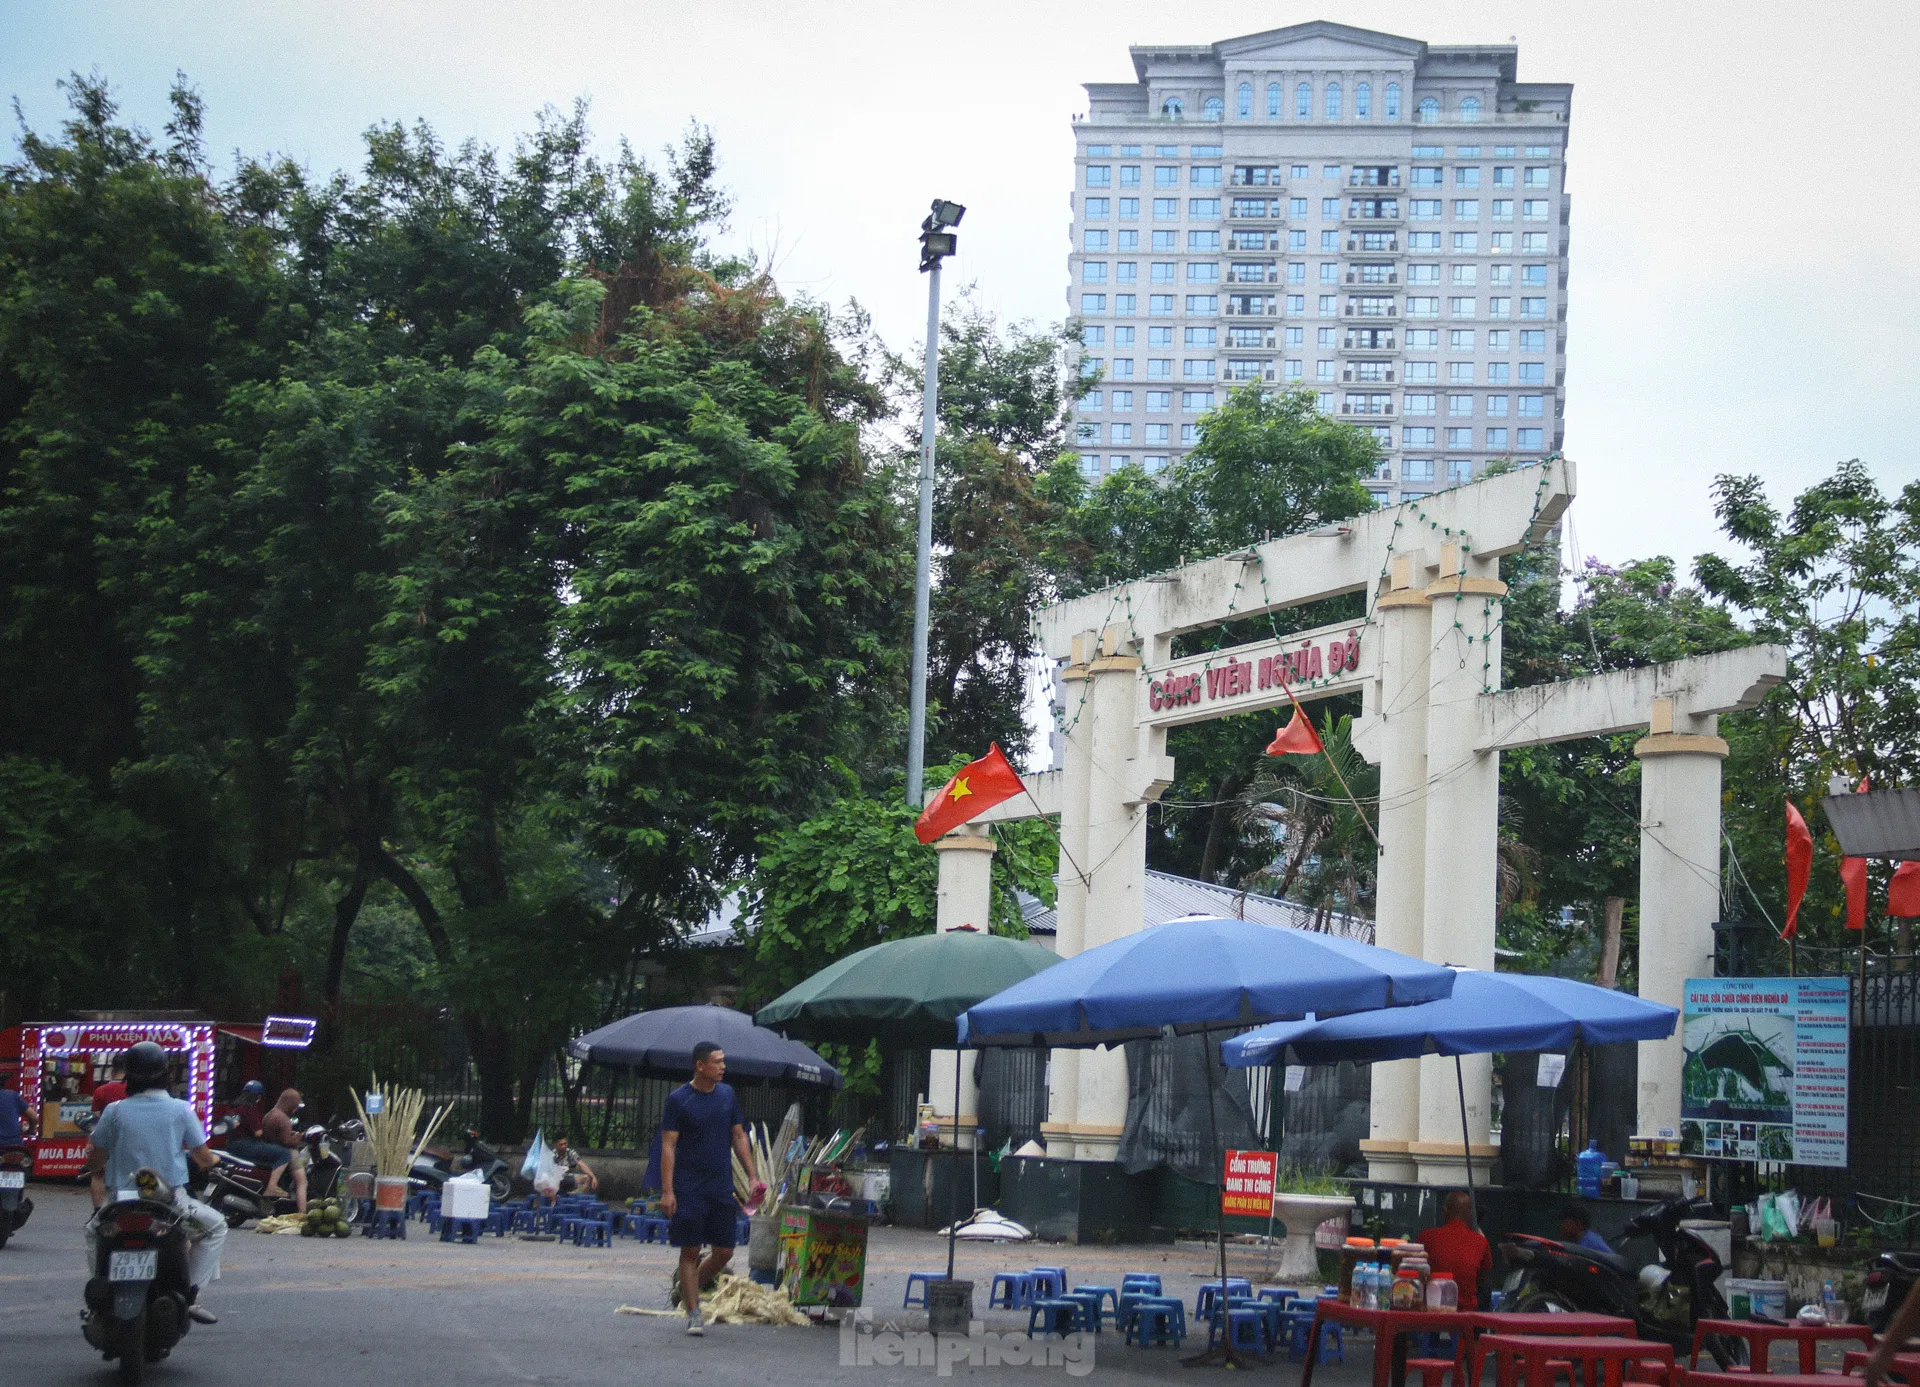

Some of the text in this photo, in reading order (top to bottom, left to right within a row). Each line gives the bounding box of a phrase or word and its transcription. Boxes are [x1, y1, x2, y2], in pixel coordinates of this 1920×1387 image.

[1150, 628, 1362, 711] CÔNG VIÊN NGHĨA ĐÔ
[89, 1033, 112, 1043] PHỤ
[115, 1031, 143, 1043] KIỆN
[38, 1148, 64, 1159] MUA
[1229, 1157, 1271, 1174] CÔNG TRƯỜNG
[1226, 1177, 1272, 1194] ĐANG THI CÔNG
